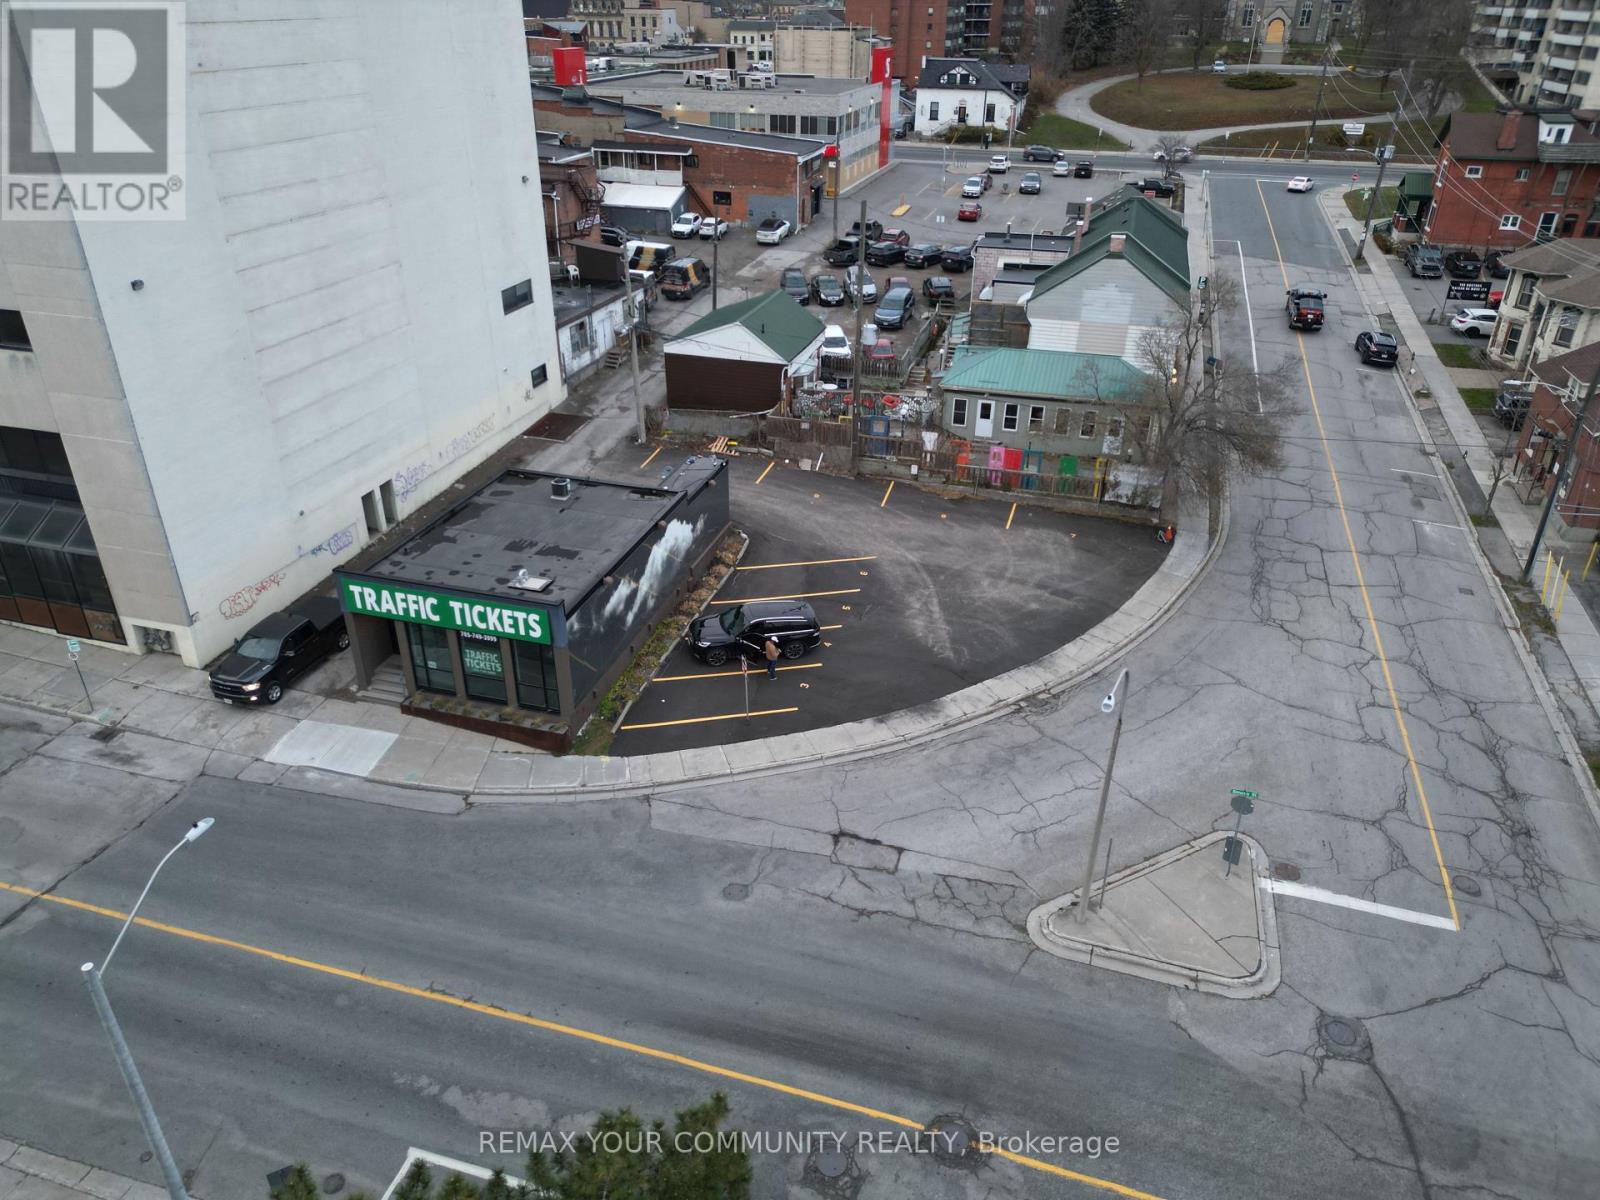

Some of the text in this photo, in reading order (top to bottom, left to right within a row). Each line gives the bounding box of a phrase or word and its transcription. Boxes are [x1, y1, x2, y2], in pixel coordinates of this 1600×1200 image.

[349, 585, 543, 638] TRAFFIC TICKETS
[465, 650, 499, 662] TRAFFIC
[465, 658, 503, 672] TICKETS
